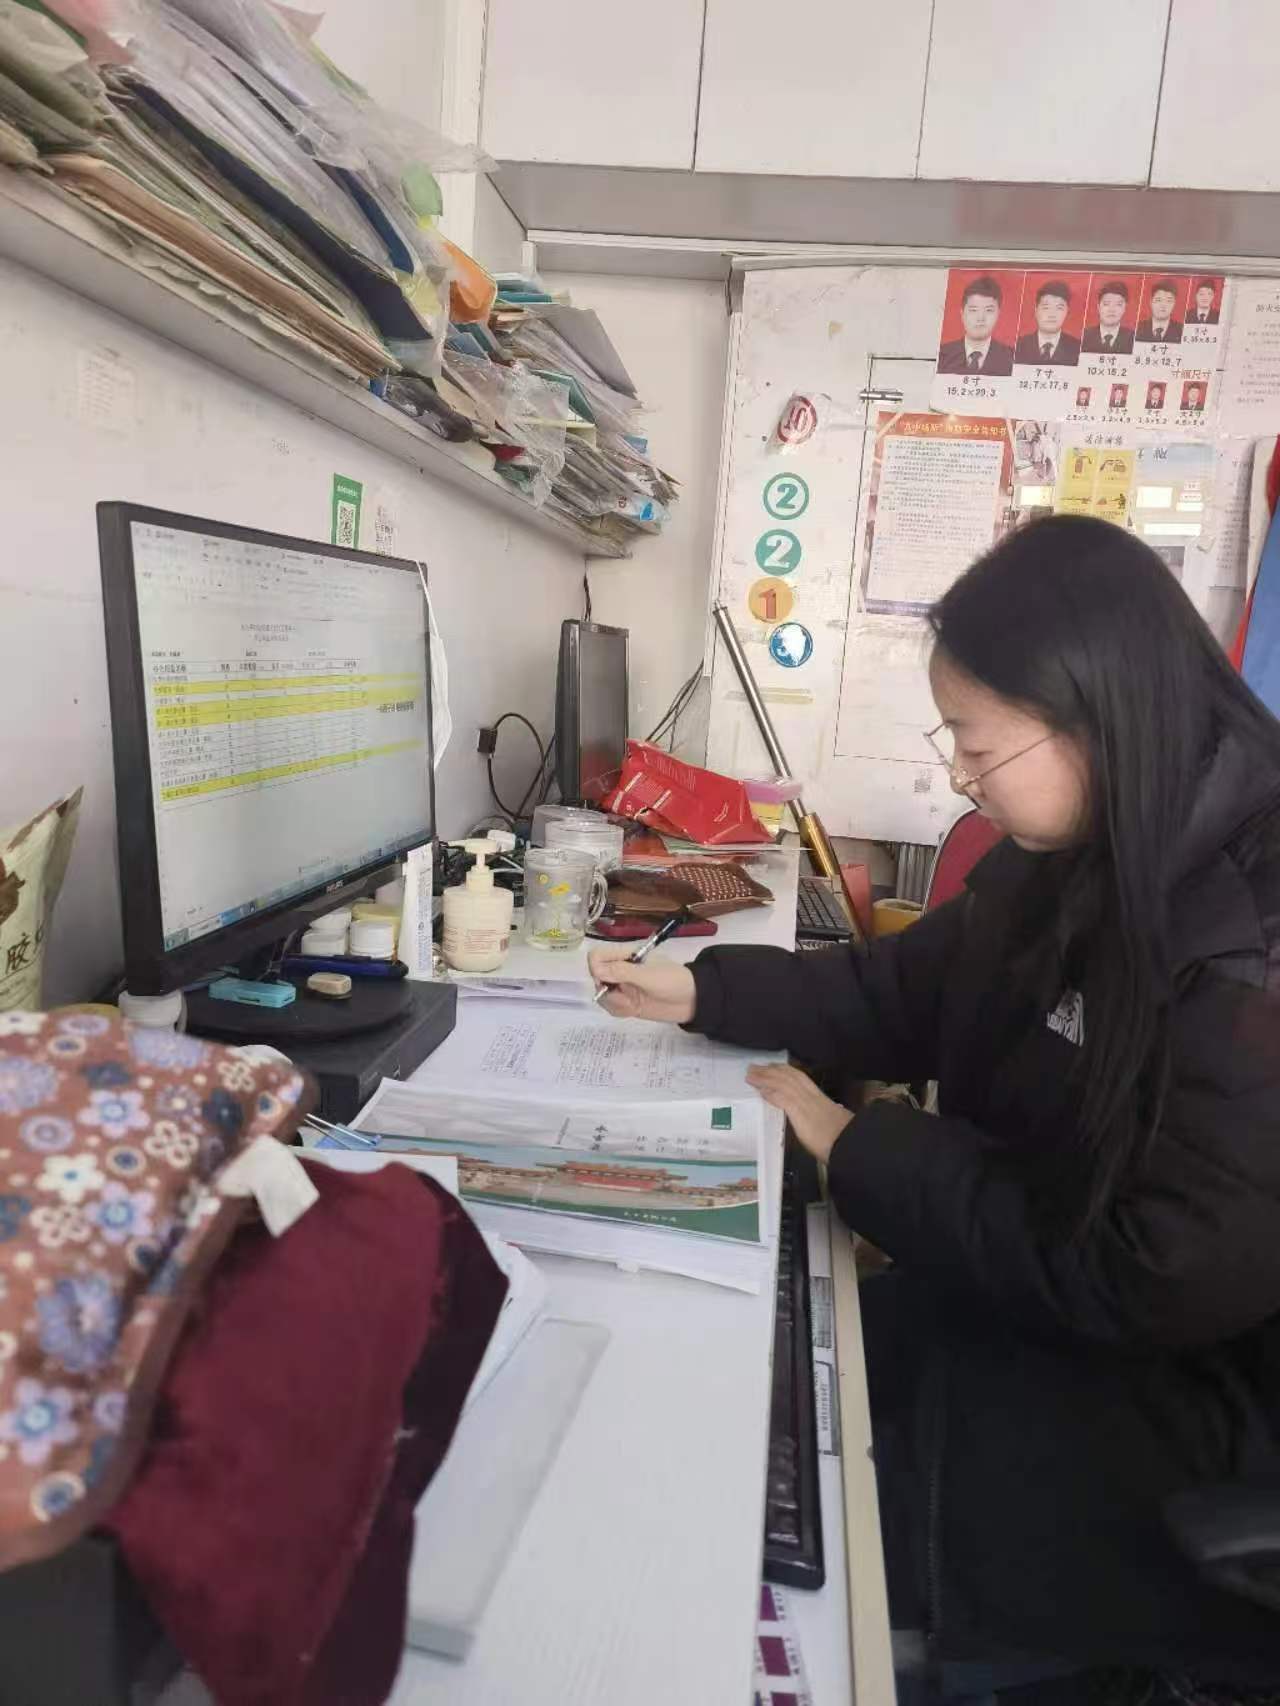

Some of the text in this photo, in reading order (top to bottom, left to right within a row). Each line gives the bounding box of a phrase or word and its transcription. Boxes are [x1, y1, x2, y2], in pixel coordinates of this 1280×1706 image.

[776, 483, 798, 509] 2
[764, 534, 793, 568] 2
[758, 588, 777, 620] 1
